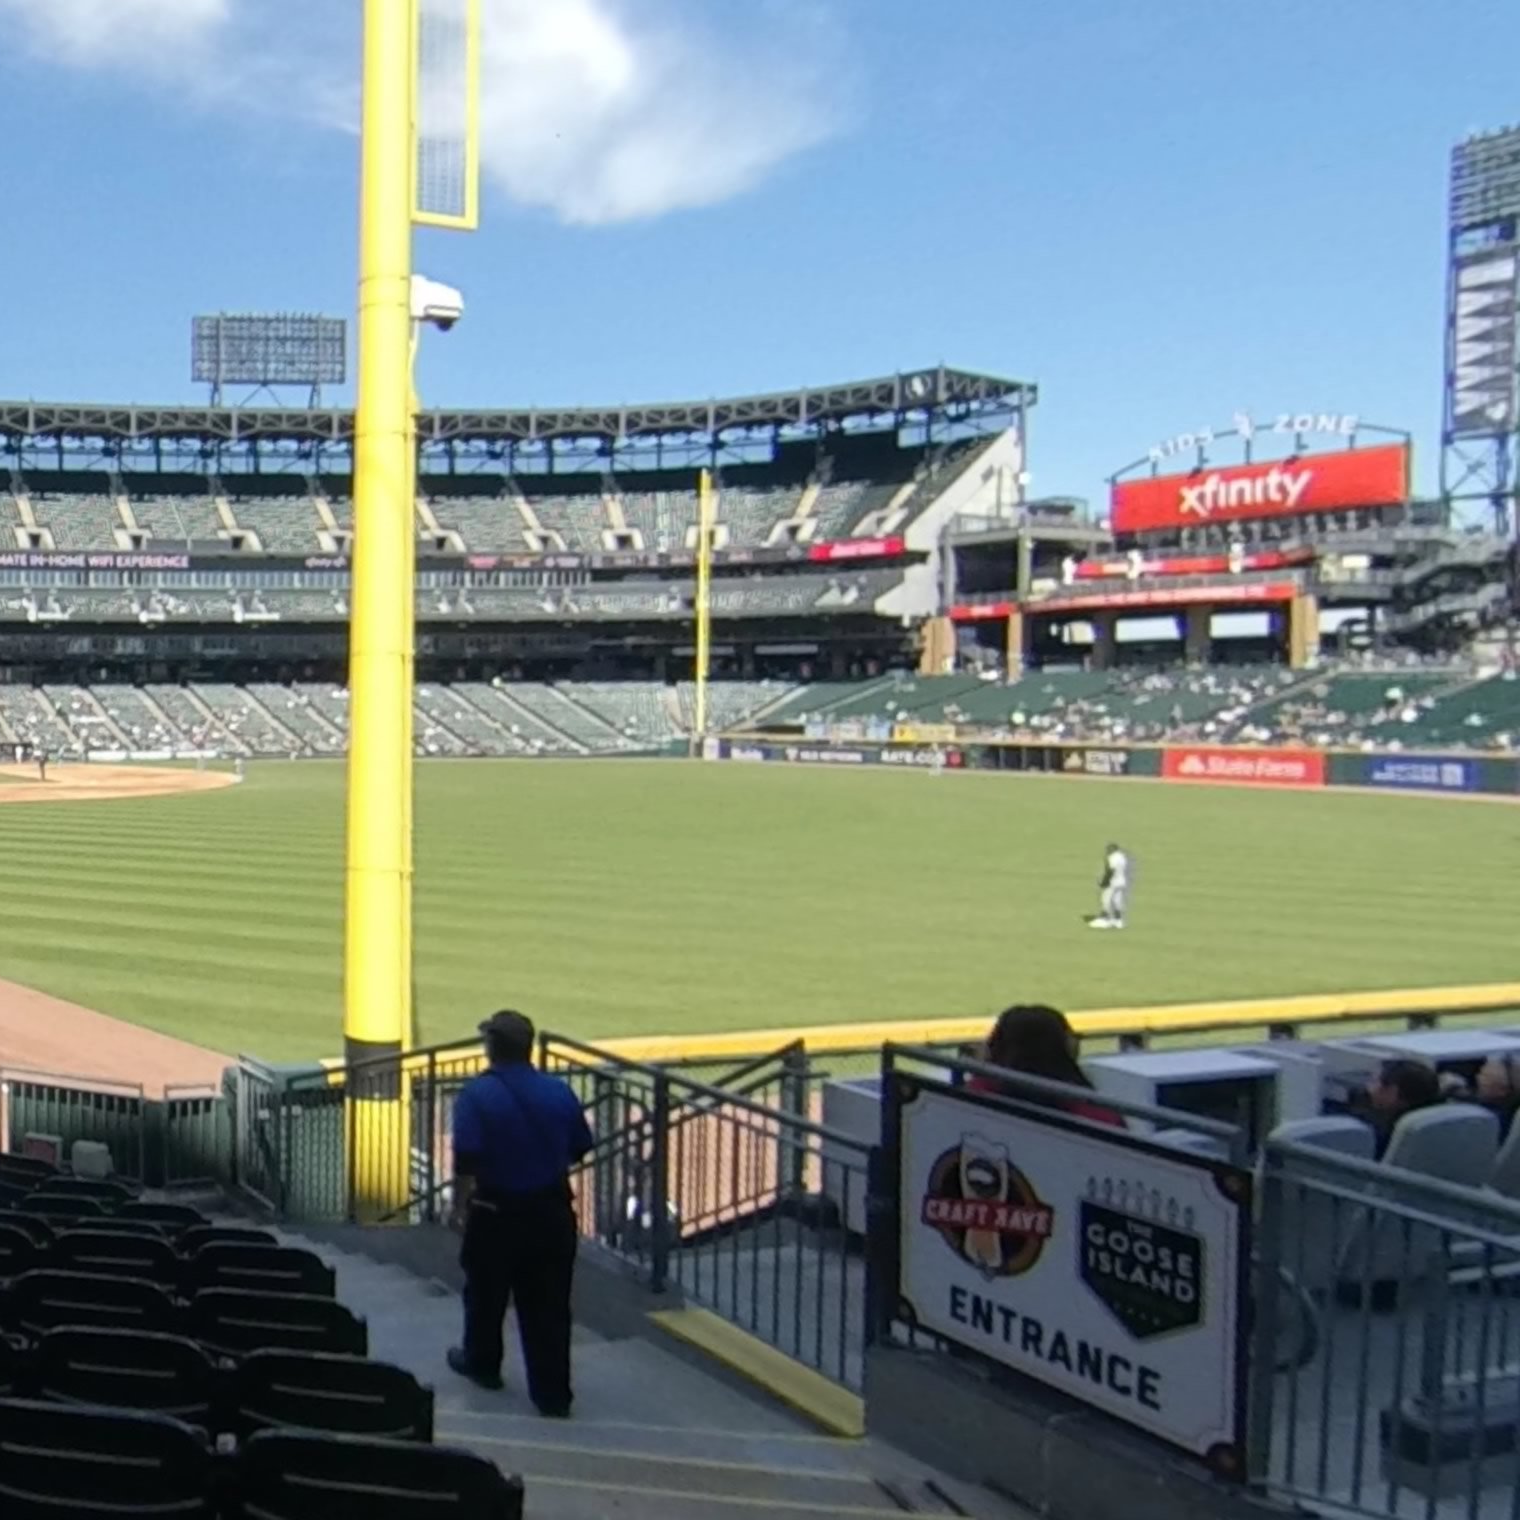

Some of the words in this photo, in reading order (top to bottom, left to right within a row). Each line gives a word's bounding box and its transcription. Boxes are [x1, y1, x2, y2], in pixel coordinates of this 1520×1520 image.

[1273, 414, 1358, 435] ZONE
[1180, 466, 1312, 517] xfinity
[31, 554, 86, 567] IN-HOME
[117, 555, 189, 568] EXPERIENCE
[1207, 755, 1254, 776] State
[1256, 757, 1306, 778] Farm
[926, 1199, 988, 1226] CRAFT
[1087, 1223, 1194, 1278] GOOSE
[1088, 1248, 1195, 1303] ISLAND
[950, 1285, 1162, 1412] ENTRANCE
